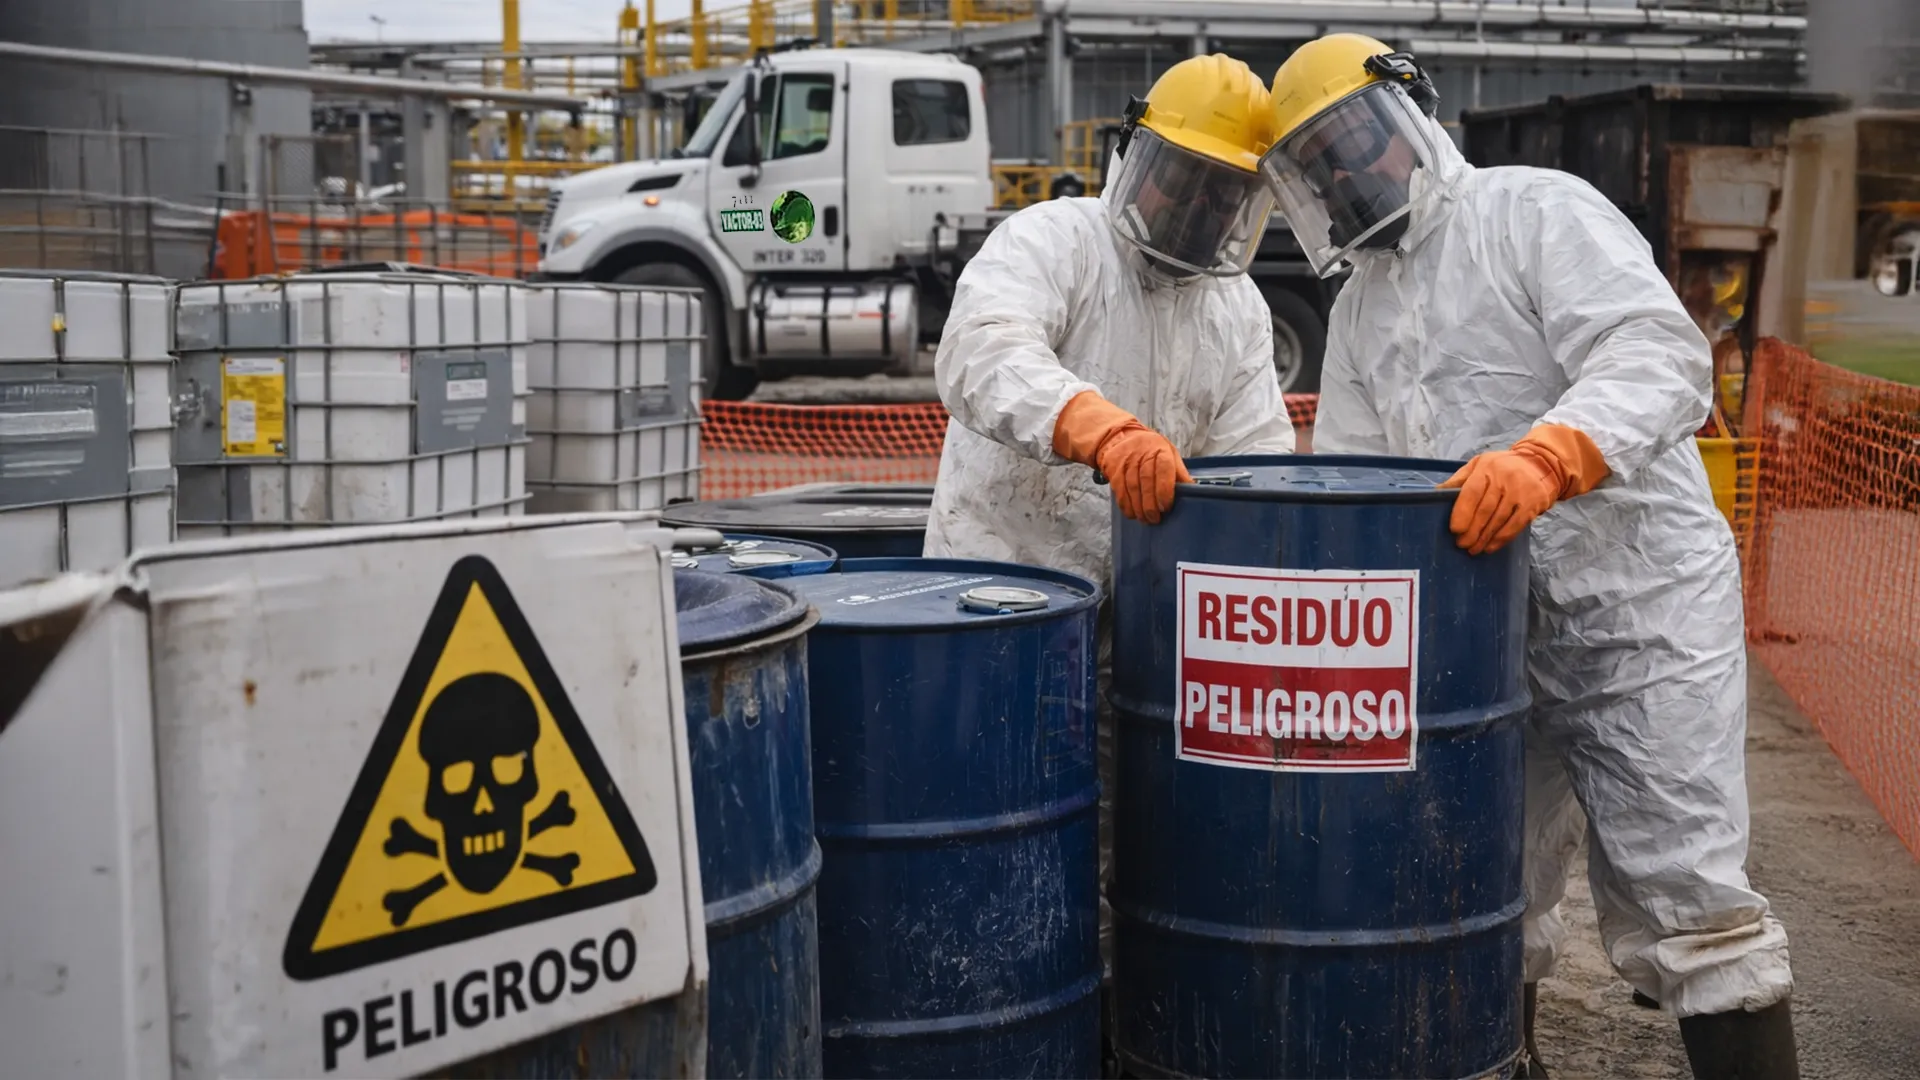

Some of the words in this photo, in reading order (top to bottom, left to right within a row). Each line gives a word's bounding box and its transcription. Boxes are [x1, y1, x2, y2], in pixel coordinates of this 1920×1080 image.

[753, 250, 794, 264] INTER
[1198, 591, 1392, 647] RESIDUO
[1185, 681, 1405, 741] PELIGROSO
[323, 928, 636, 1072] PELIGROSO
